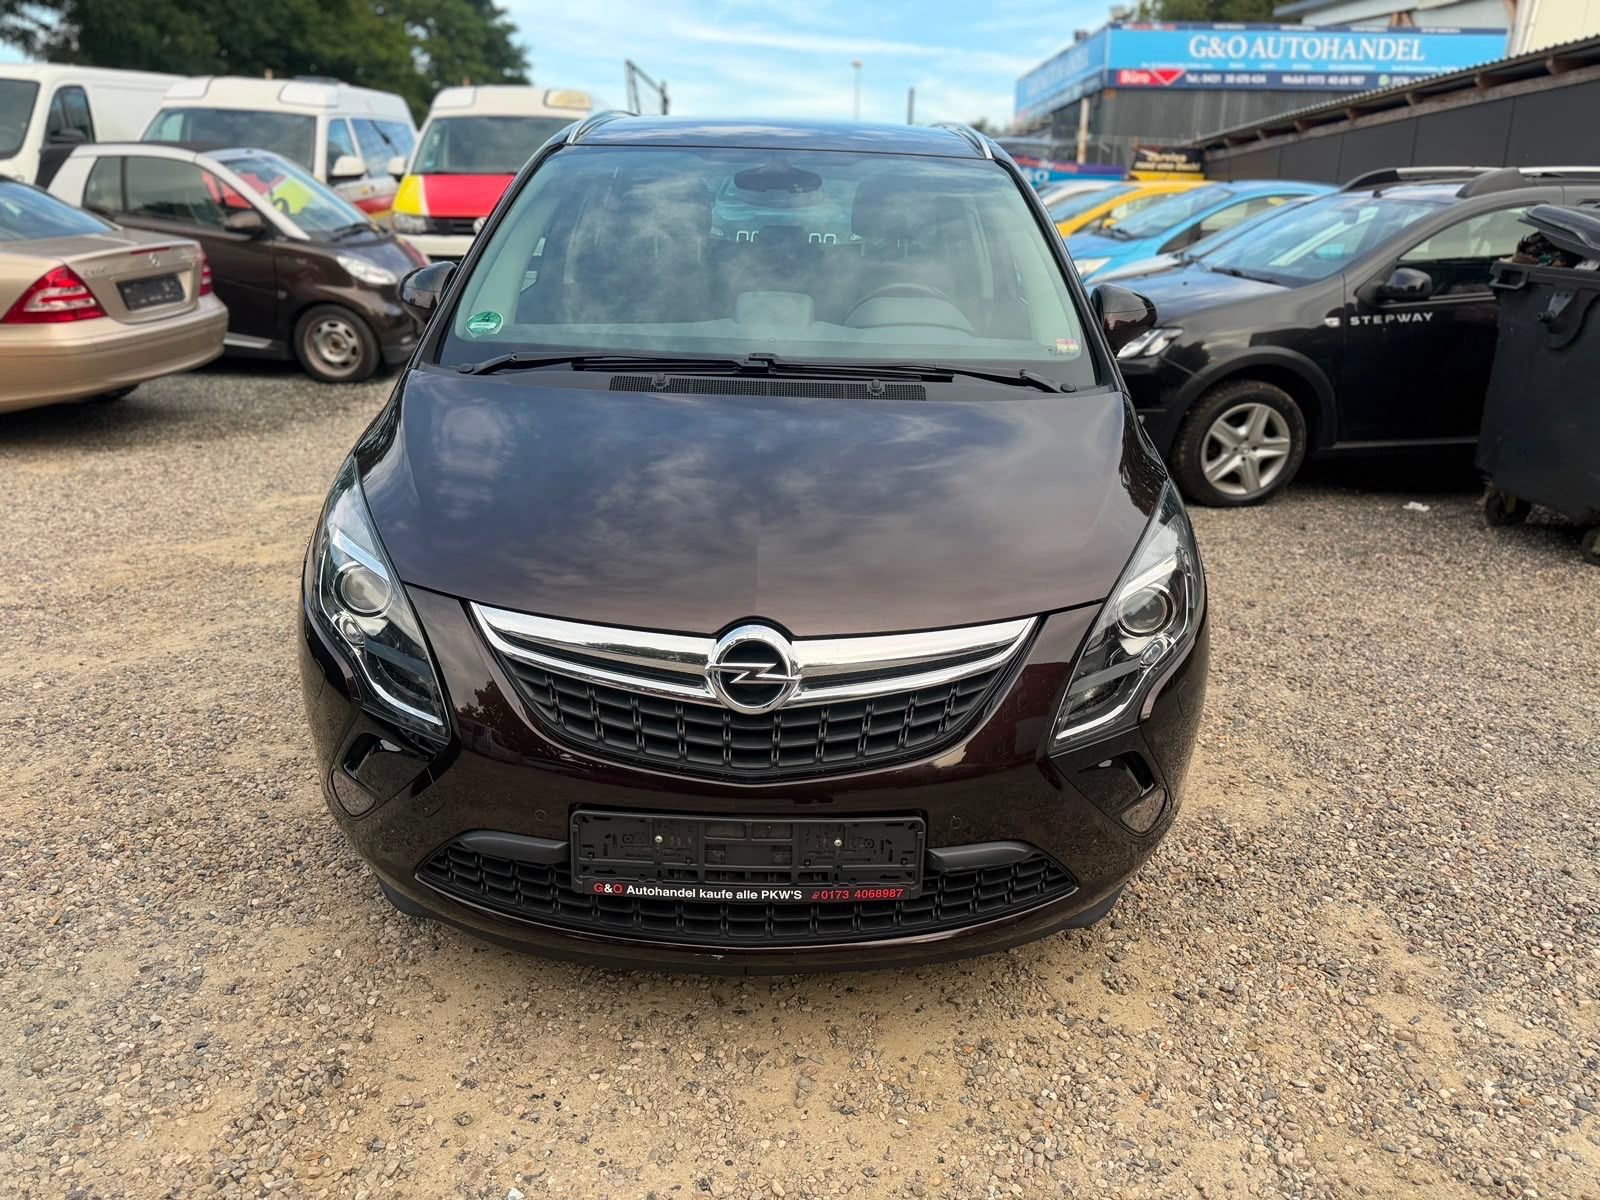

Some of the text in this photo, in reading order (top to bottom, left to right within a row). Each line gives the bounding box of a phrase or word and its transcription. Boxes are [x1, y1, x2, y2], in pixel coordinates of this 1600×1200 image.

[1188, 34, 1425, 61] G&O AUTOHANDEL
[1349, 312, 1433, 327] STEPWAY
[593, 883, 904, 900] G&O Autohandel kaufe alle PKW'S 0173 4068987
